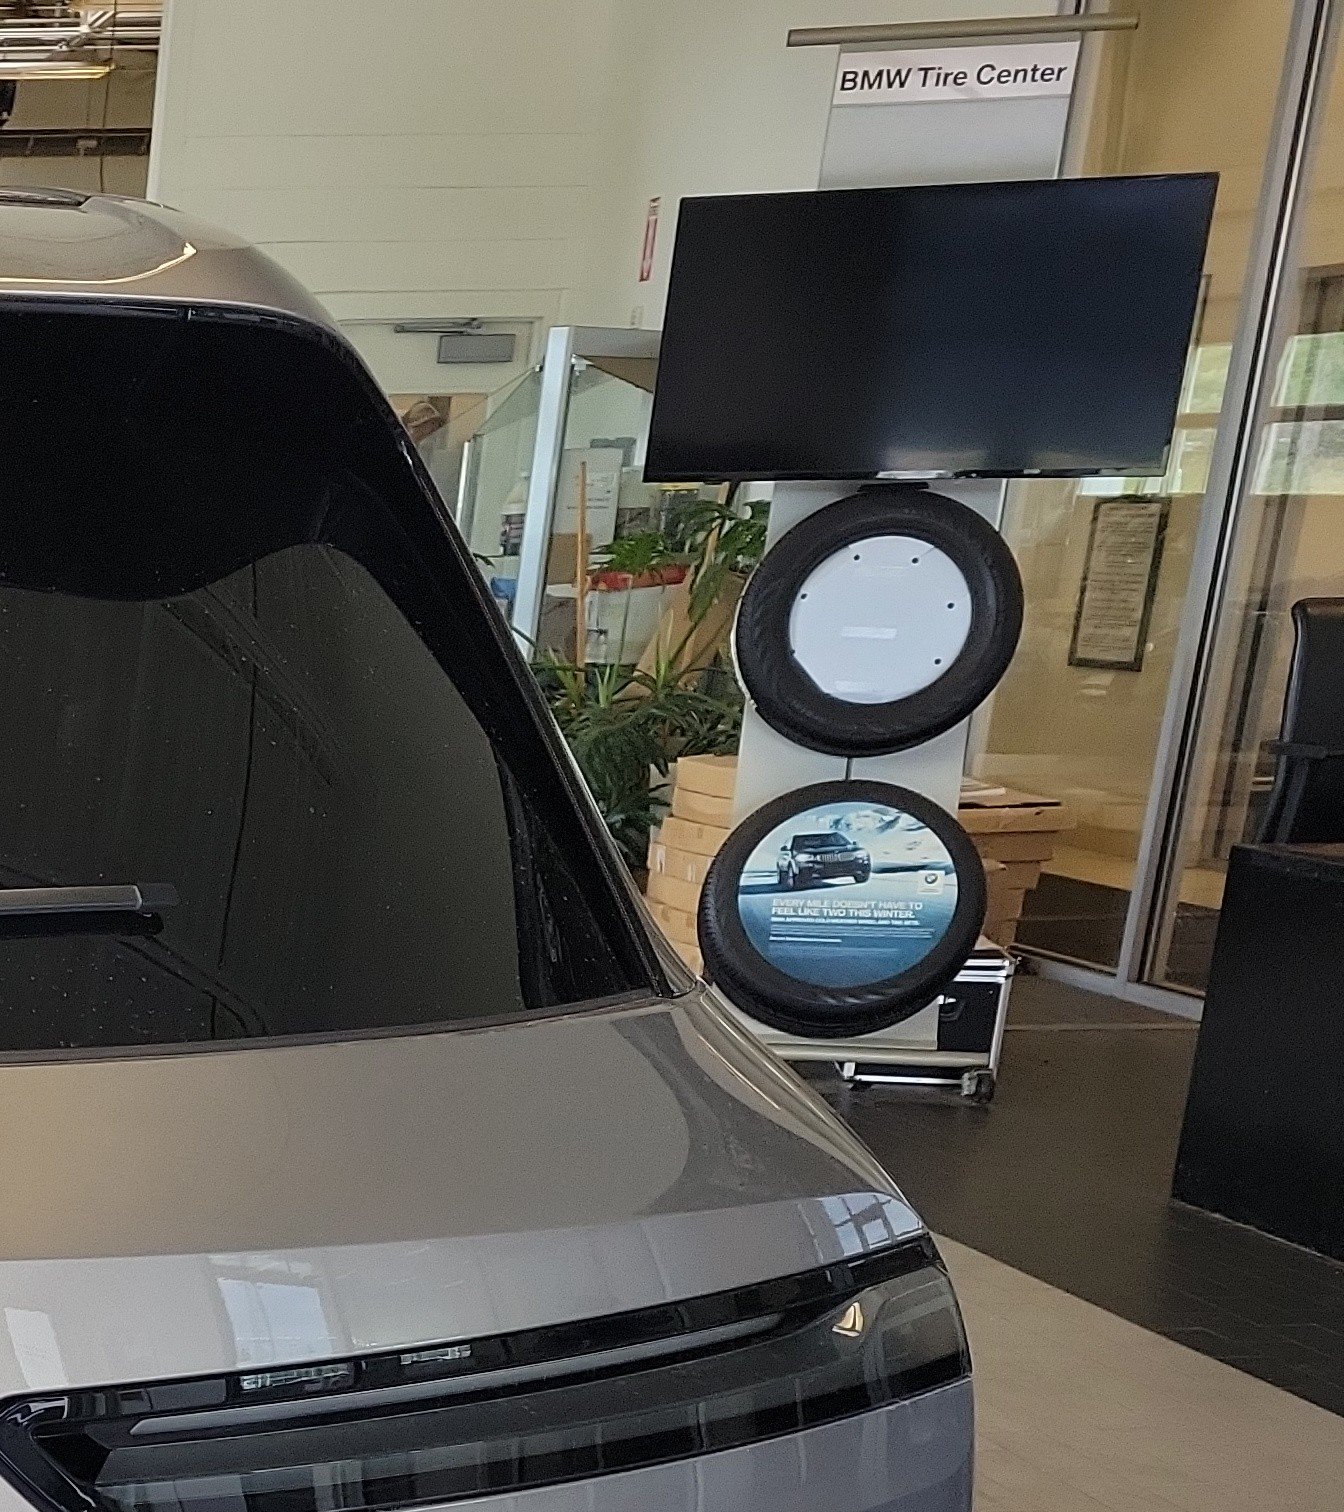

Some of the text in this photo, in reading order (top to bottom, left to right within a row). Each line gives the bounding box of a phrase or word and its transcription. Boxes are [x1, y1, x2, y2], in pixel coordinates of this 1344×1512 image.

[839, 63, 1068, 92] BMW Tire Center
[909, 902, 923, 911] TO
[772, 907, 798, 916] FEEL
[798, 908, 820, 916] LIKE
[823, 908, 848, 917] TWO
[849, 909, 871, 918] THIS
